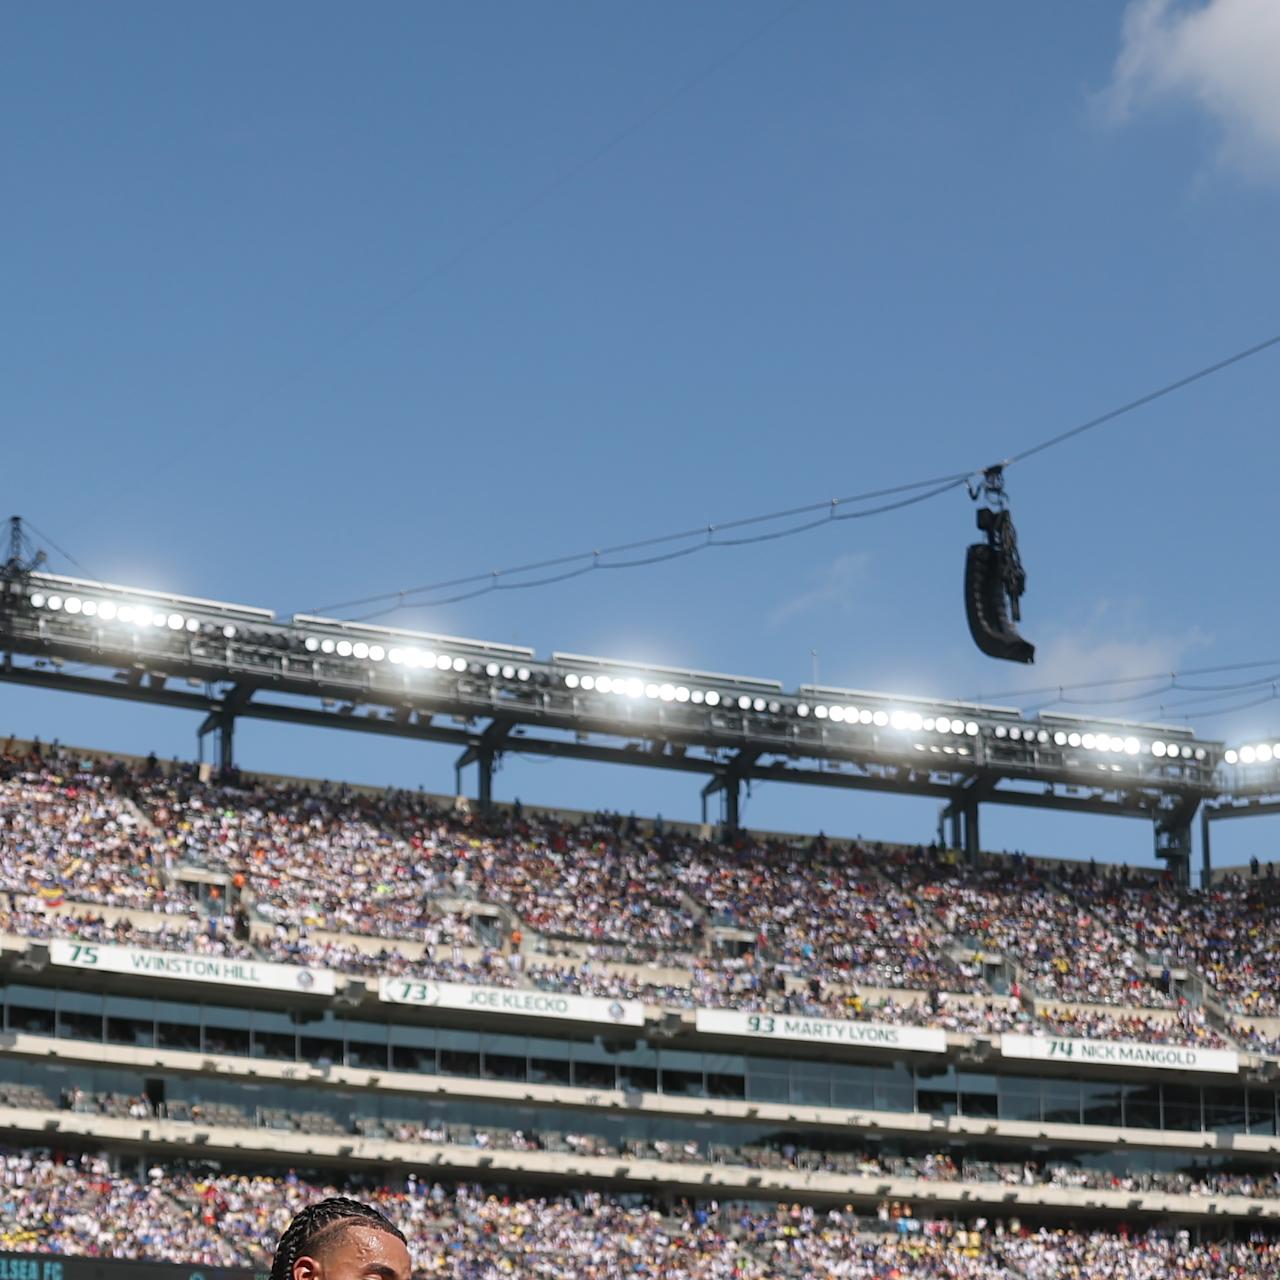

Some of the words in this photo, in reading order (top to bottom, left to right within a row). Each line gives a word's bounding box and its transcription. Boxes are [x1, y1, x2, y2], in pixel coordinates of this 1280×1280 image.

[67, 944, 100, 965] 75
[131, 953, 220, 980] WINSTON
[222, 962, 261, 983] HILL
[399, 981, 429, 1000] 73
[468, 990, 499, 1006] JOE
[502, 993, 569, 1013] KLECKO
[747, 1016, 776, 1034] 93
[784, 1020, 846, 1041] MARTY
[848, 1026, 899, 1044] LYONS
[1046, 1040, 1074, 1057] 74
[1081, 1044, 1115, 1061] NICK
[1118, 1047, 1197, 1066] MANGOLD
